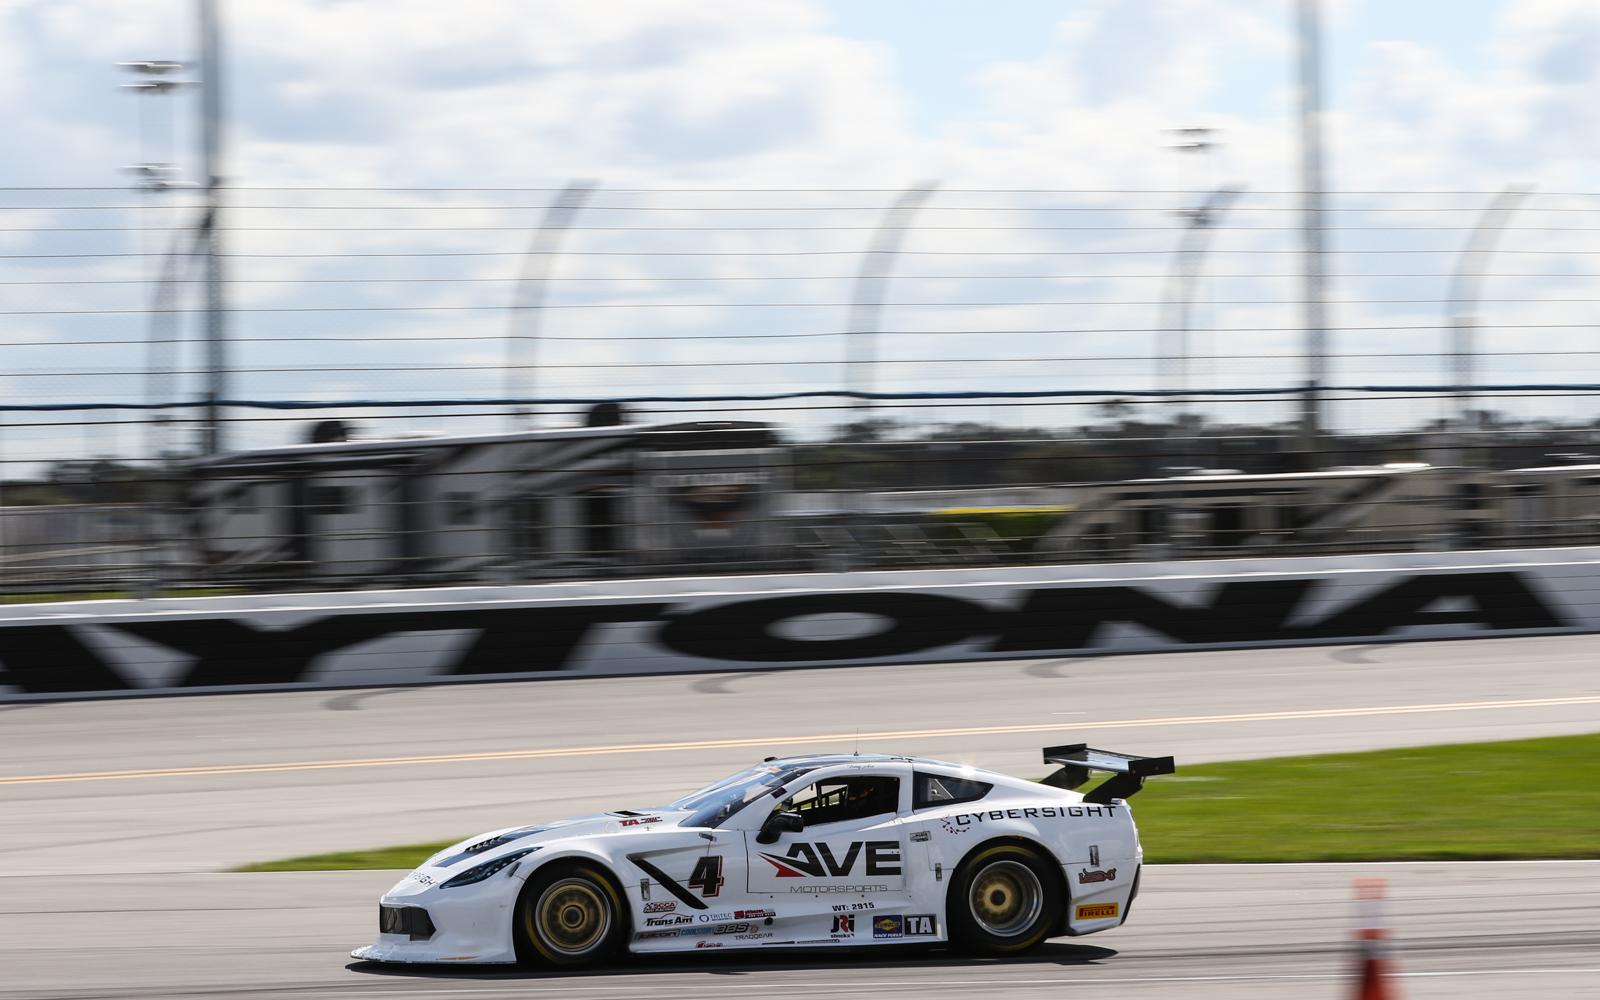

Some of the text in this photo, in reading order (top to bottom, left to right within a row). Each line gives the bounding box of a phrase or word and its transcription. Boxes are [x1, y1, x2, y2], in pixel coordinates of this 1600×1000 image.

[955, 806, 1117, 826] CYBERSIGHT
[758, 841, 902, 878] AVE
[688, 855, 724, 898] 4
[789, 884, 888, 894] MOTORSPORTS
[851, 902, 875, 911] 2915
[1079, 905, 1115, 918] PIRELLI
[645, 915, 693, 927] Trans Am
[907, 917, 933, 934] TA
